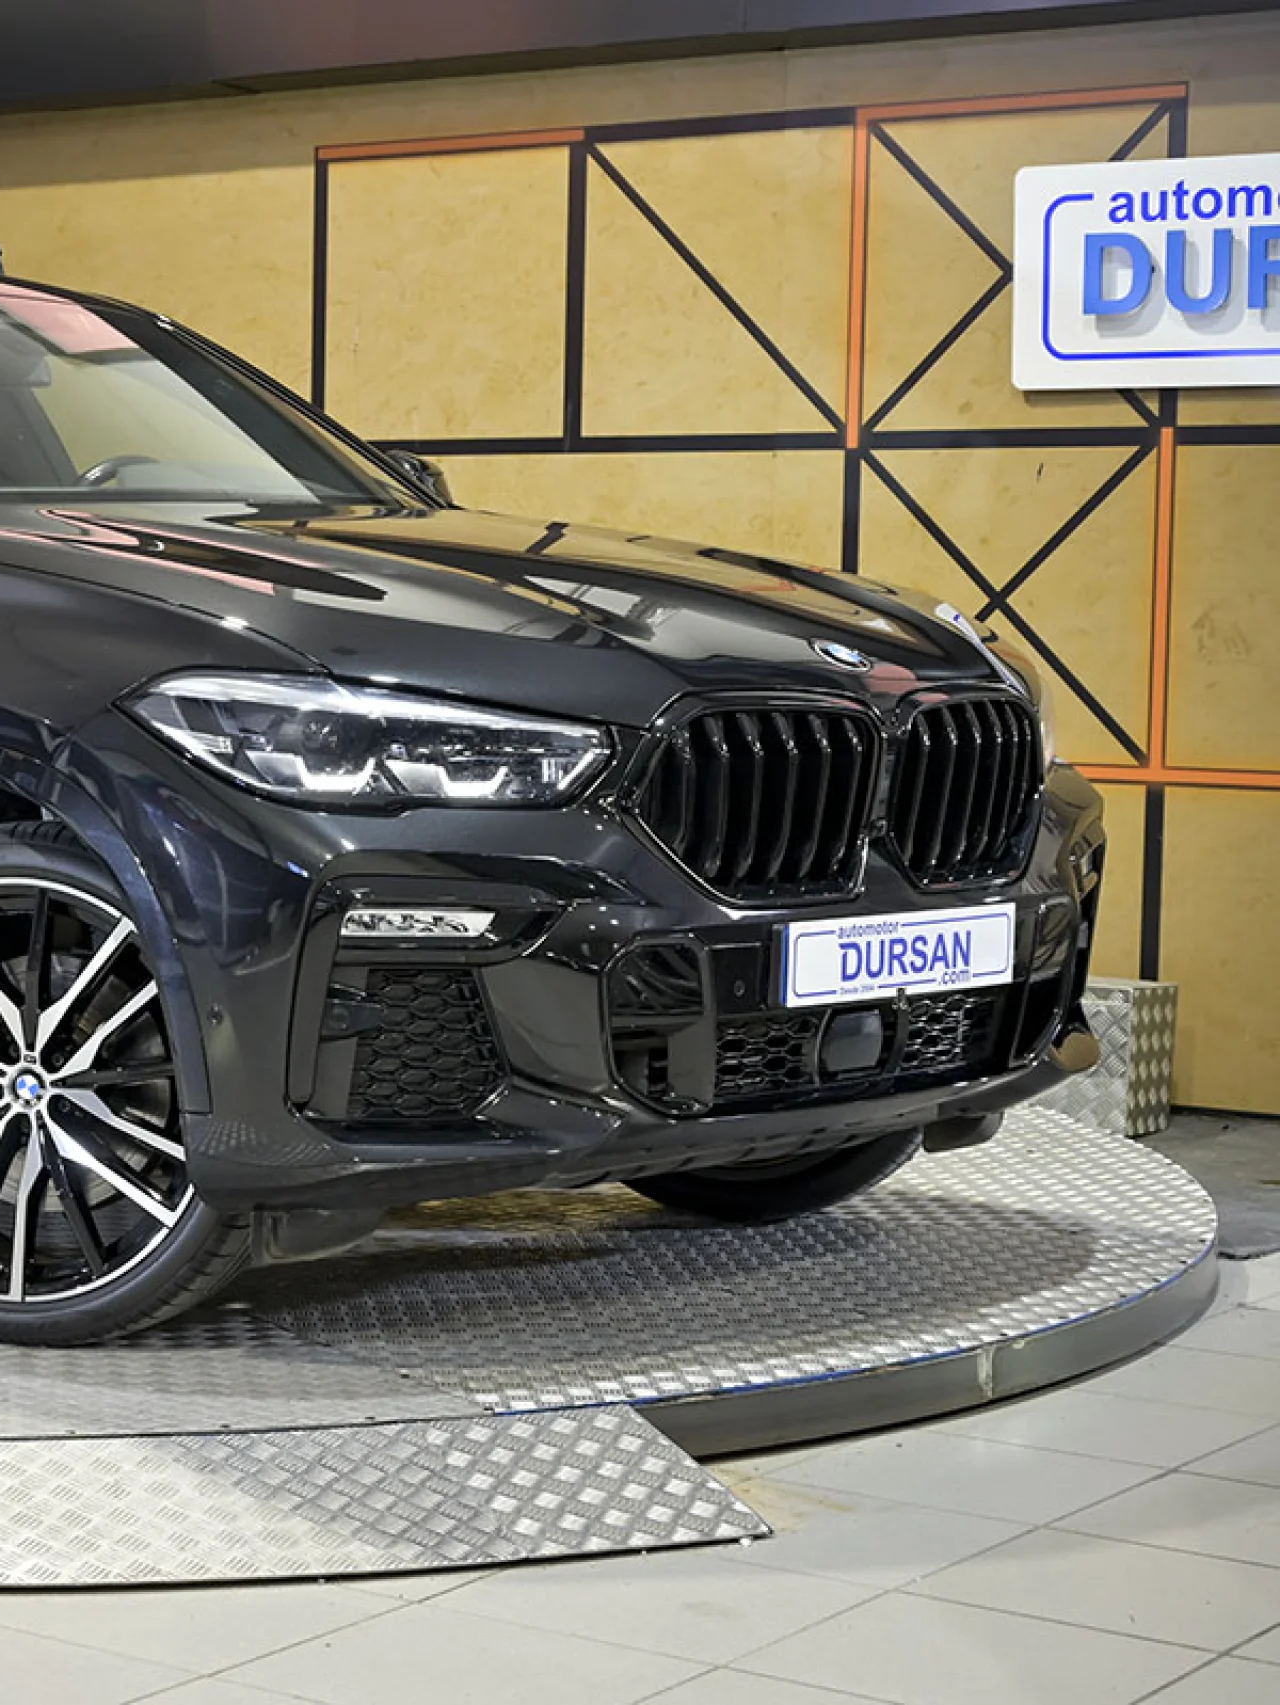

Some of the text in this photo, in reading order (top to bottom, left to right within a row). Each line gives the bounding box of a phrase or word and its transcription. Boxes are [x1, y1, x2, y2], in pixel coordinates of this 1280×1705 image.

[1108, 178, 1280, 224] autom
[837, 921, 900, 940] automotor
[838, 929, 972, 982] DURSAN
